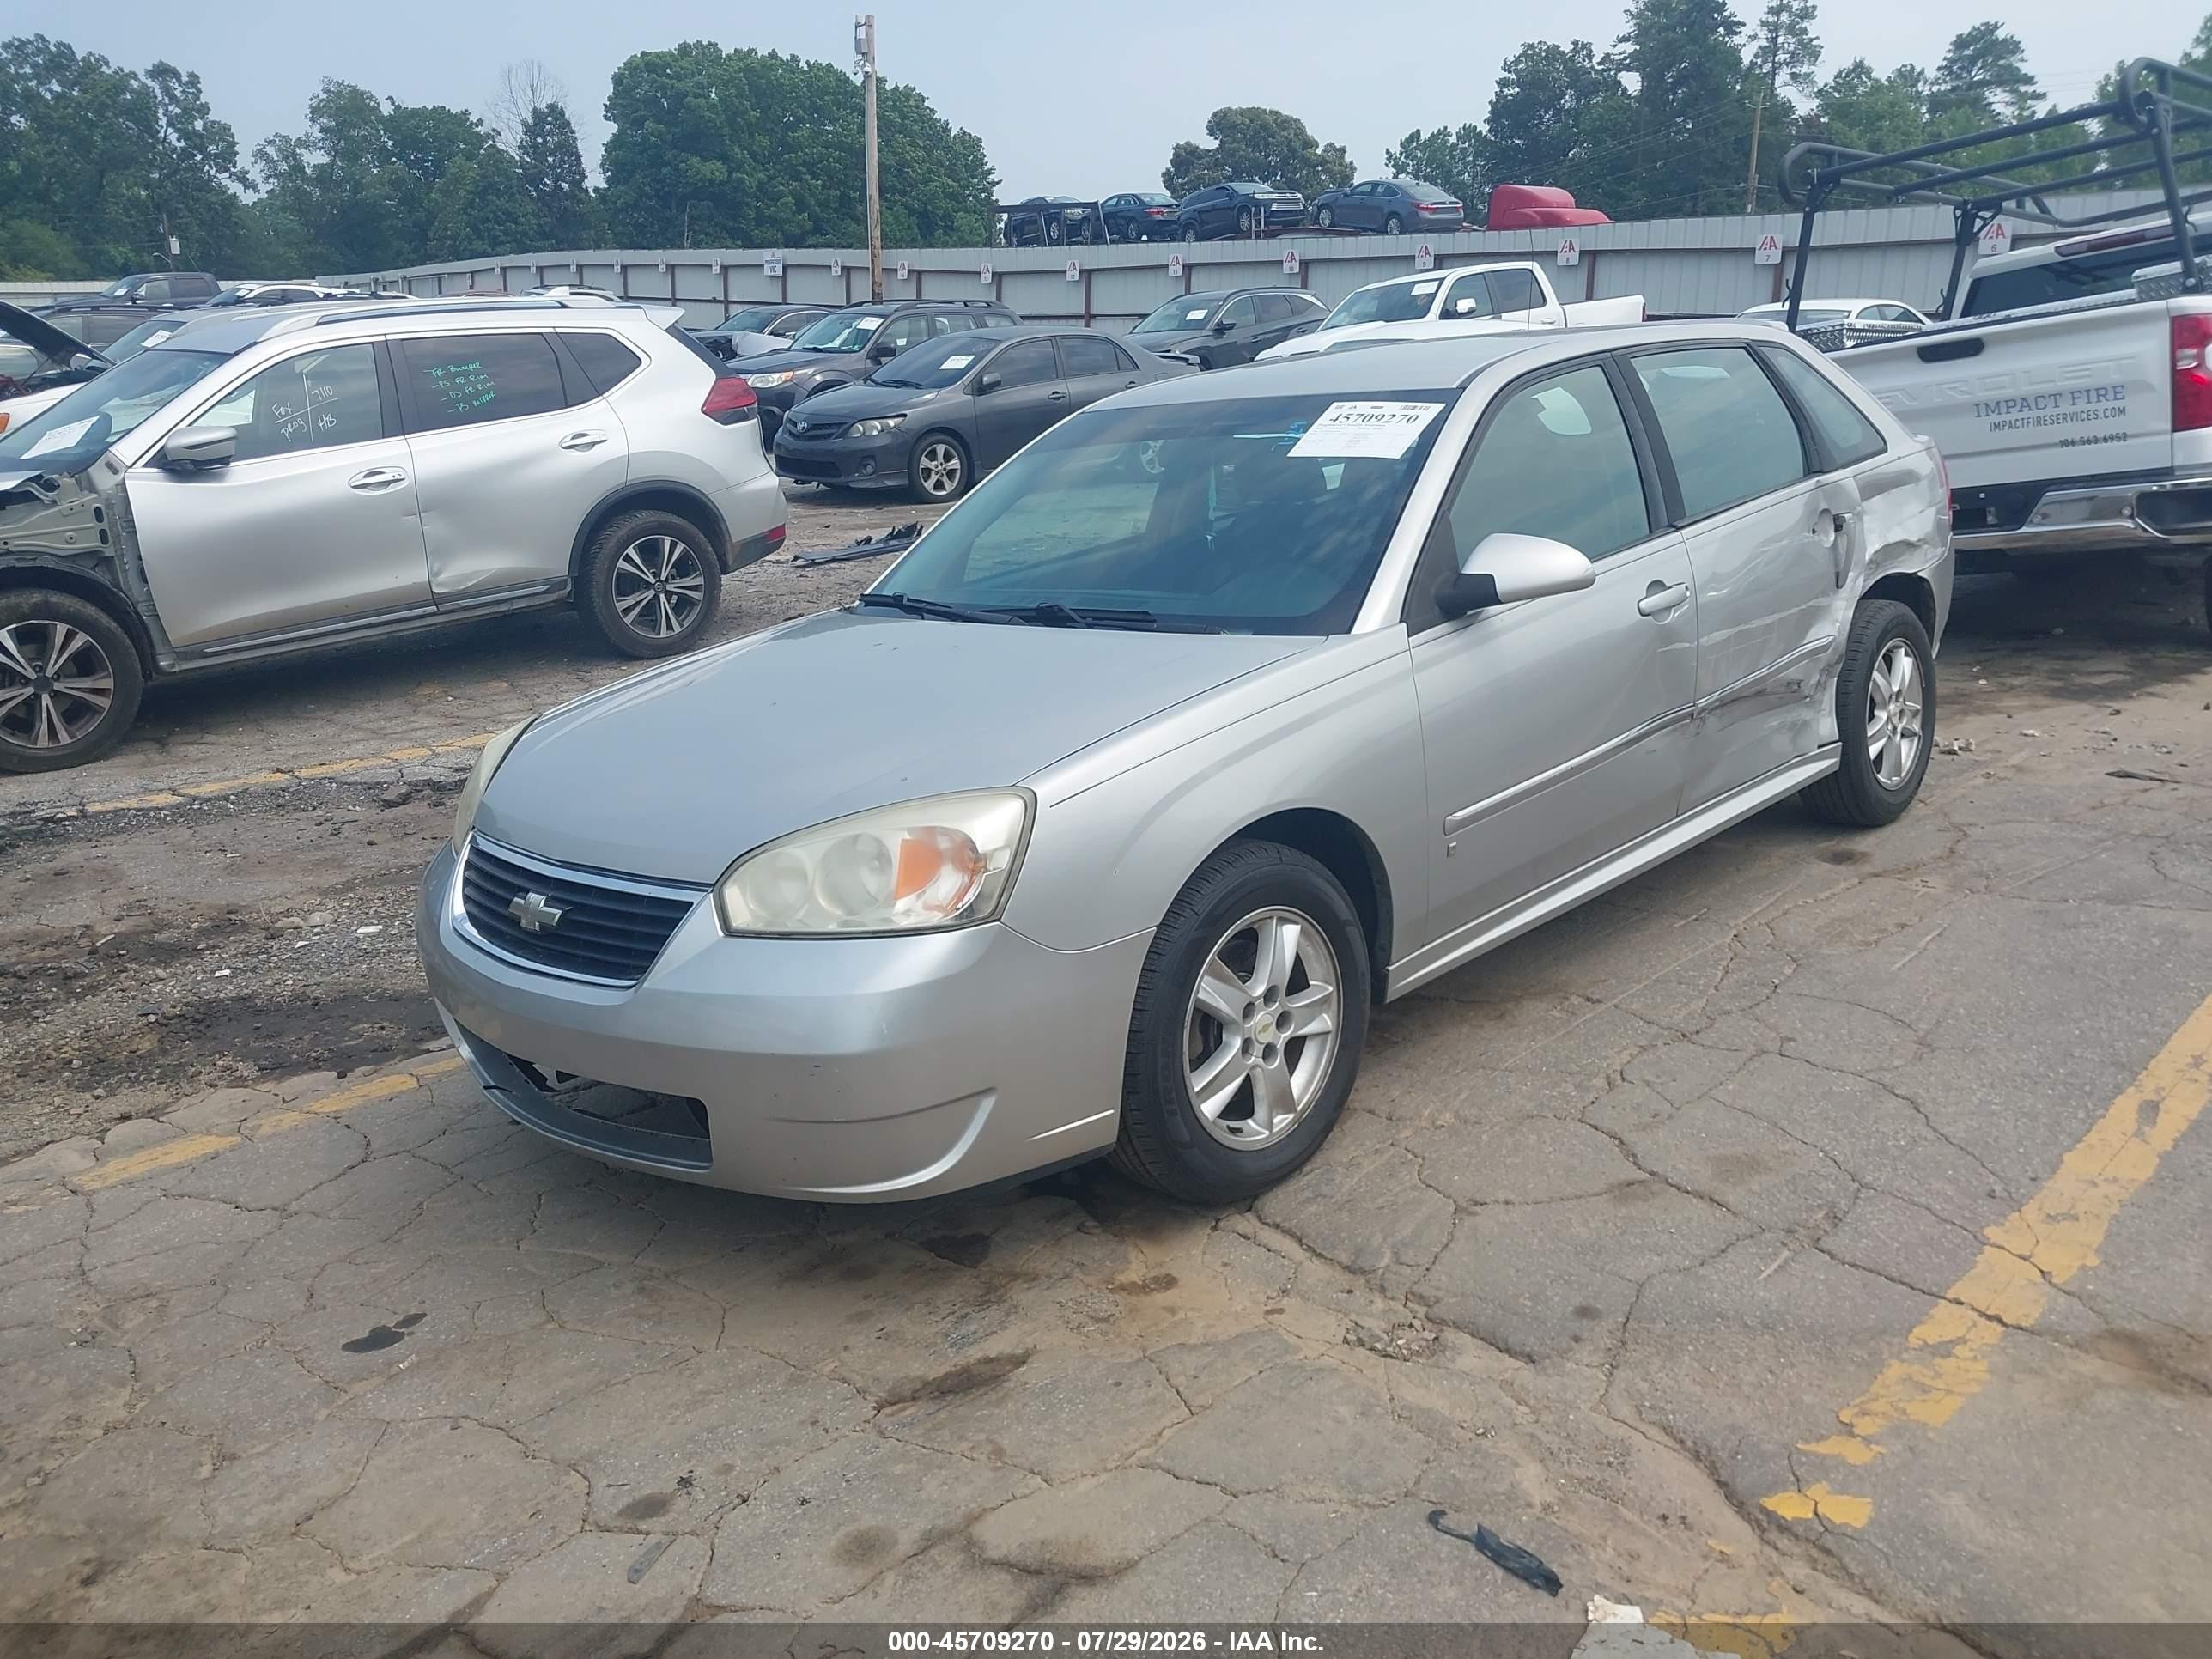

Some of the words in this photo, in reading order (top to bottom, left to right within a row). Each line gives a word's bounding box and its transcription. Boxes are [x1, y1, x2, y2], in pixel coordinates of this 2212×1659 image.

[1973, 393, 2063, 418] IMPACT
[2069, 385, 2126, 407] FIRE
[1329, 413, 1419, 423] 45709270
[1990, 406, 2127, 432] IMPACTFIRESERVICES.COM
